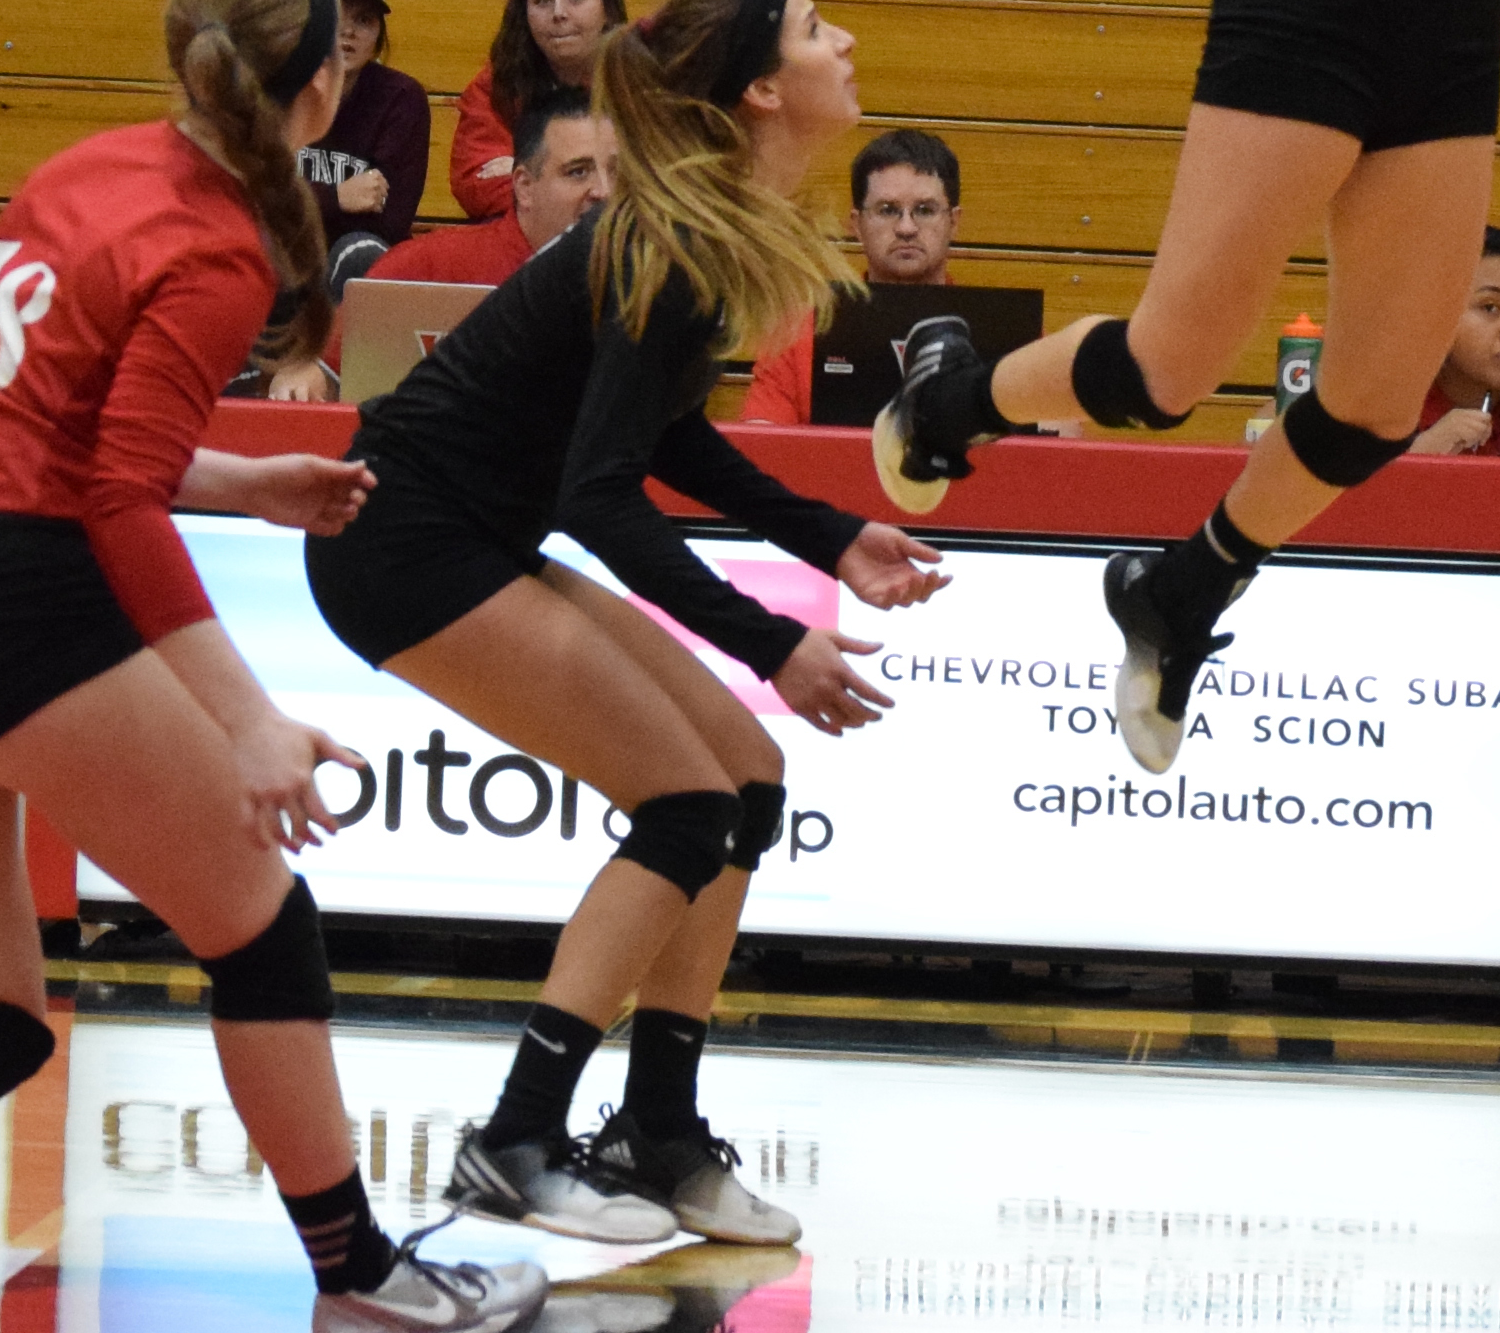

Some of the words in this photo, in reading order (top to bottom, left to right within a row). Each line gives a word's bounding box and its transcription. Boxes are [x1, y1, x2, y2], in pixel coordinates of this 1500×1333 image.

[1283, 359, 1310, 393] G
[1197, 668, 1378, 703] ADILLAC
[1041, 704, 1214, 740] TOYA
[1253, 714, 1386, 748] SCION
[1012, 773, 1434, 830] capitolauto.com
